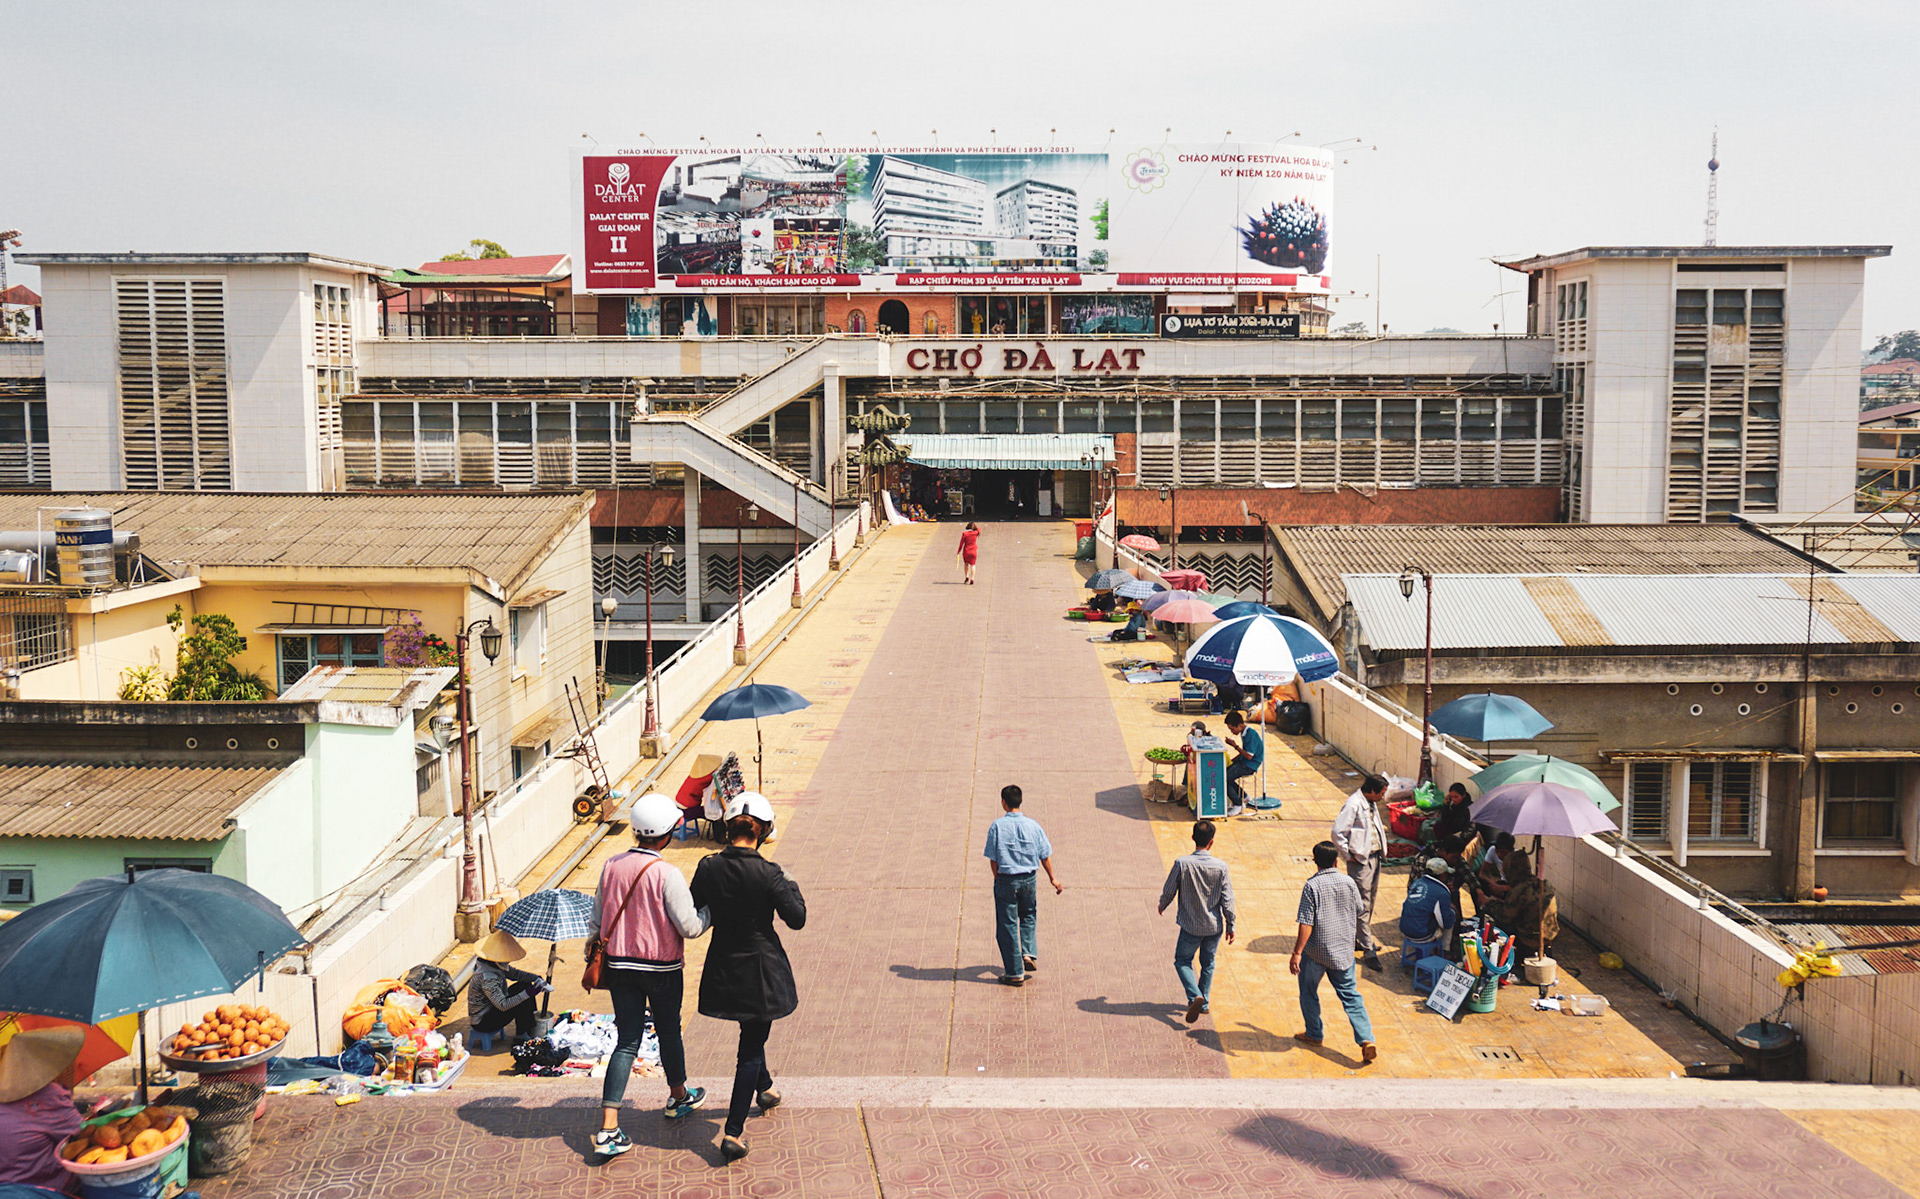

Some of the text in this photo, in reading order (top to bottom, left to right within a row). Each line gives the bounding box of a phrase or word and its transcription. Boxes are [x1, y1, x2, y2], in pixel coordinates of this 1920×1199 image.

[1178, 153, 1209, 162] CHÀO
[1247, 155, 1291, 164] FESTIVAL
[1293, 157, 1310, 165] HOA
[1266, 170, 1282, 178] 120
[594, 184, 646, 196] DALAT
[610, 236, 627, 252] II
[906, 341, 1145, 376] CHỢ ĐÀ LẠT
[1195, 654, 1234, 664] mobifone
[1295, 652, 1331, 665] mobifone
